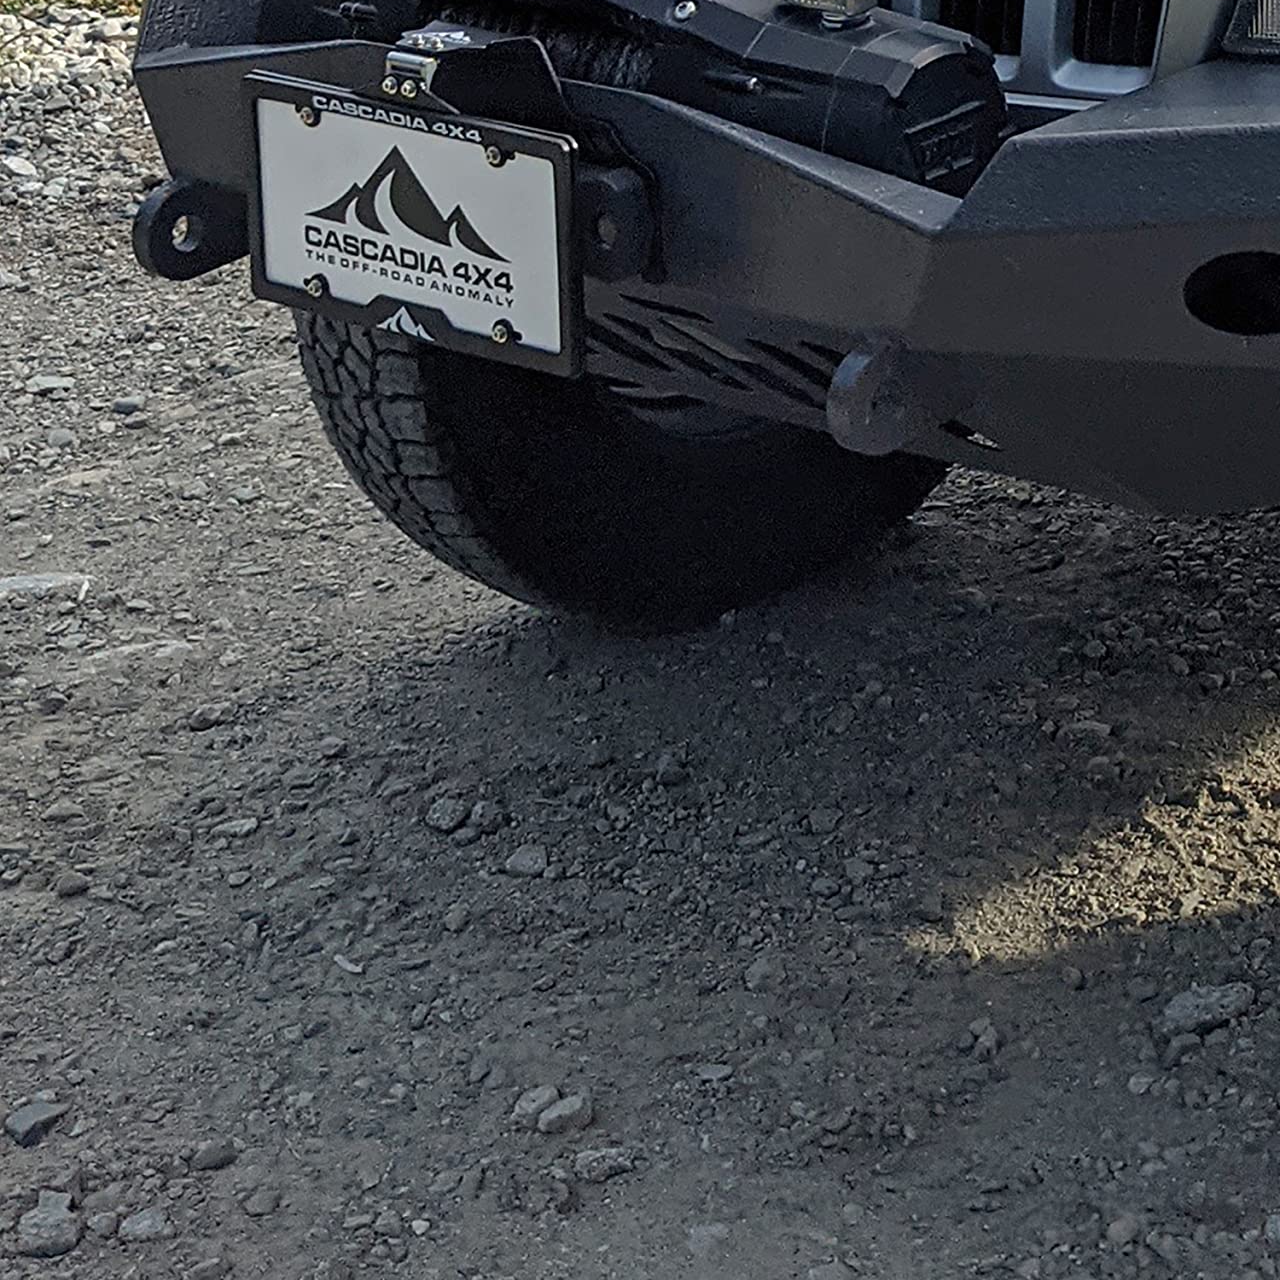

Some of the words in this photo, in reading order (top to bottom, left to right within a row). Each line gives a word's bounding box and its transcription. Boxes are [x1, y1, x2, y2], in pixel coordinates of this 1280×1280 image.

[312, 95, 429, 131] CASCADIA
[432, 122, 482, 142] 4X4
[304, 224, 448, 278] CASCADIA
[452, 261, 514, 294] 4X4
[305, 249, 335, 265] THE
[340, 258, 425, 287] OFF-ROAD
[430, 280, 515, 309] ANOMALY
